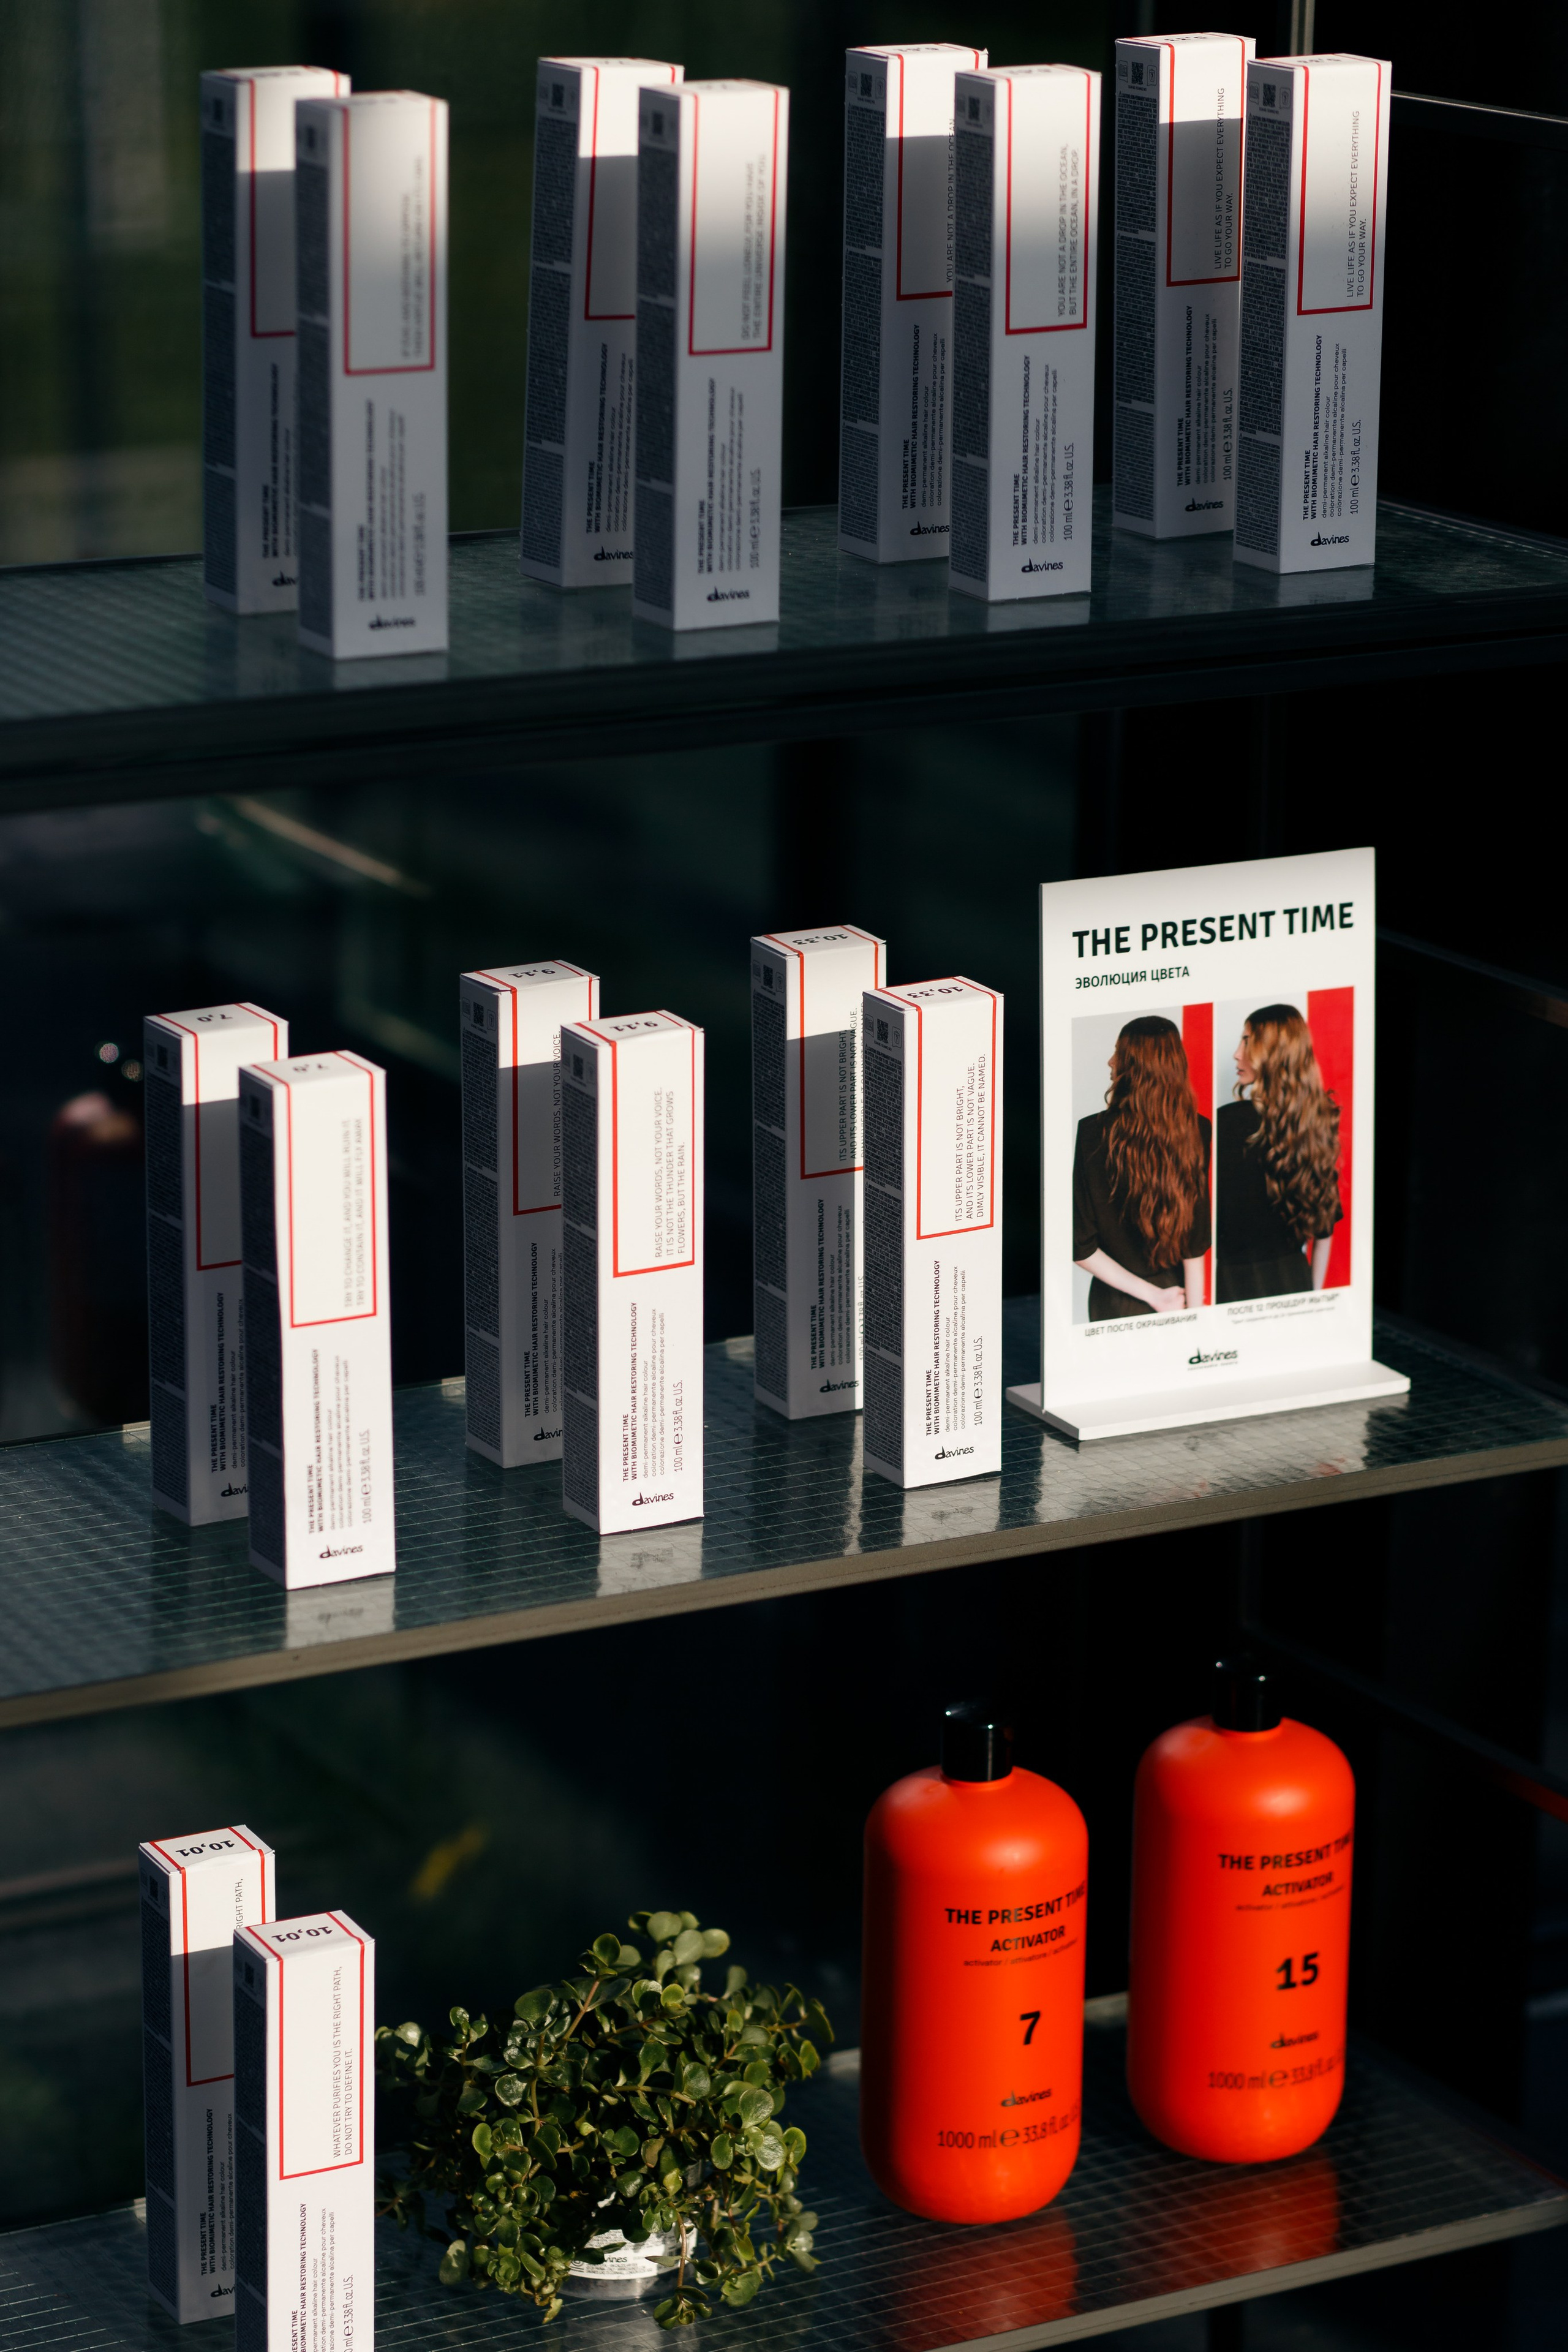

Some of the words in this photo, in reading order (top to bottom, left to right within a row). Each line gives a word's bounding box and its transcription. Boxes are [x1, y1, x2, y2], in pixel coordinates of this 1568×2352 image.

[1351, 111, 1359, 169] EVERYTHING
[1348, 230, 1355, 238] IF
[1348, 240, 1355, 253] AS
[1357, 269, 1365, 282] GO
[1357, 285, 1364, 297] TO
[1351, 419, 1361, 435] U.S.
[1351, 455, 1360, 473] 3.38
[1349, 486, 1359, 497] ml
[1185, 497, 1223, 511] davines
[1349, 499, 1359, 514] 100
[910, 521, 950, 535] davines
[1310, 532, 1349, 546] davines
[1021, 557, 1063, 573] davines
[1072, 925, 1131, 958] THE
[1141, 910, 1276, 951] PRESENT
[1283, 902, 1354, 935] TIME
[792, 933, 848, 945] 10,33
[508, 968, 556, 979] 9,11
[1075, 970, 1147, 989] ЭВОЛЮЦИЯ
[1151, 966, 1189, 983] ЦВЕТА
[907, 986, 964, 998] 10,33
[956, 1085, 965, 1120] BRIGHT,
[978, 1091, 985, 1102] BE
[665, 1091, 674, 1125] GROWS
[967, 1117, 974, 1126] IS
[956, 1142, 963, 1150] IS
[976, 1153, 985, 1189] VISIBLE,
[654, 1166, 663, 1202] WORDS,
[654, 1204, 663, 1229] YOUR
[677, 1208, 686, 1253] FLOWERS,
[666, 1237, 674, 1245] IS
[1227, 1305, 1254, 1316] ПОСЛЕ
[1265, 1298, 1306, 1312] ПРОЦЕДУР
[1085, 1326, 1104, 1336] ЦВЕТ
[1107, 1322, 1134, 1334] ПОСЛЕ
[1136, 1313, 1197, 1330] ОКРАШИВАНИЯ
[973, 1335, 982, 1351] U.S.
[1188, 1348, 1238, 1365] davines
[819, 1379, 858, 1393] davines
[973, 1370, 982, 1386] 3.38
[973, 1399, 982, 1409] ml
[973, 1411, 982, 1425] 100
[934, 1446, 974, 1460] davines
[631, 1492, 674, 1506] davines
[319, 1545, 363, 1558] davines
[176, 1840, 235, 1856] 10,01
[1218, 1854, 1254, 1870] THE
[1261, 1844, 1332, 1870] PRESENT
[235, 1879, 244, 1902] PATH,
[1262, 1871, 1333, 1897] ACTIVATOR
[945, 1909, 982, 1924] THE
[988, 1896, 1063, 1924] PRESENT
[1065, 1880, 1085, 1908] TIME
[271, 1926, 333, 1942] 10,01
[990, 1925, 1065, 1952] ACTIVATOR
[333, 1966, 342, 1991] PATH,
[1276, 1952, 1319, 1990] 15
[333, 1993, 341, 2019] RIGHT
[1019, 2010, 1041, 2046] 7
[333, 2039, 341, 2048] IS
[1270, 2030, 1319, 2049] davines
[1208, 2071, 1245, 2090] 1000
[1248, 2070, 1267, 2089] ml
[344, 2093, 352, 2105] TO
[1001, 2089, 1052, 2107] davines
[937, 2130, 974, 2149] 1000
[978, 2130, 996, 2149] ml
[1023, 2122, 1047, 2144] 33.8
[344, 2142, 352, 2155] DO
